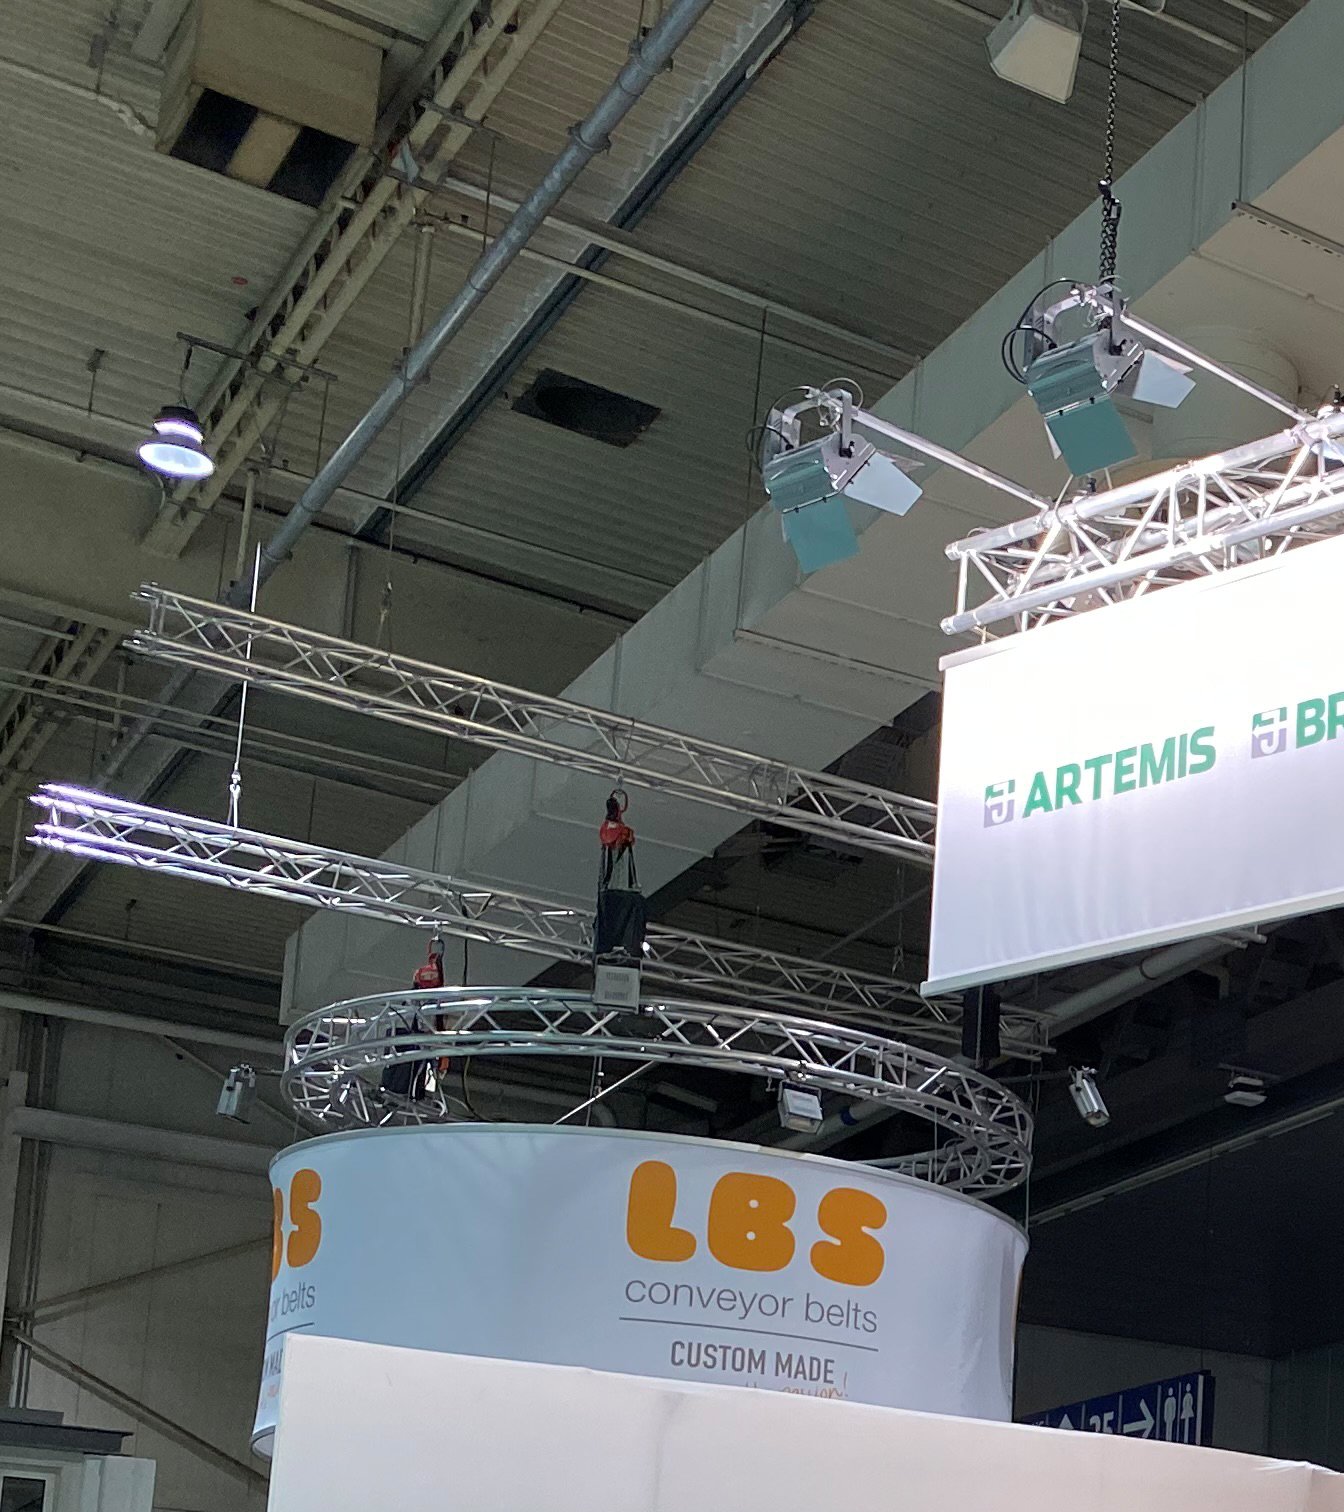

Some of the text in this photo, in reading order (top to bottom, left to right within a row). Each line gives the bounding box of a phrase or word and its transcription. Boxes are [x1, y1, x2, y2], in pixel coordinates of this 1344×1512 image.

[1021, 726, 1217, 818] ARTEMIS
[626, 1160, 888, 1287] LBS
[281, 1282, 316, 1317] belts
[625, 1280, 878, 1333] conveyor belts
[671, 1341, 835, 1385] CUSTOM MADE
